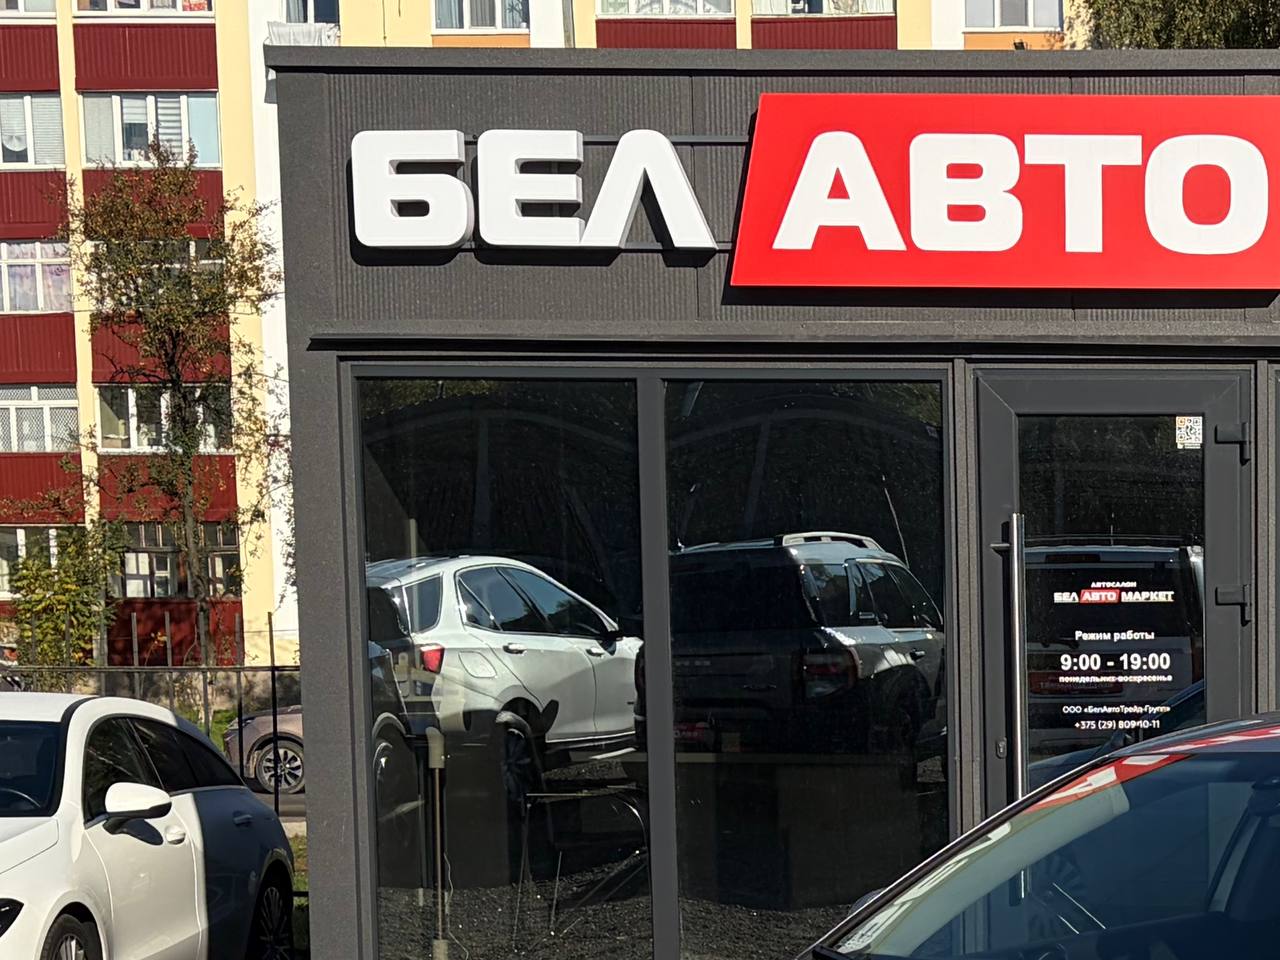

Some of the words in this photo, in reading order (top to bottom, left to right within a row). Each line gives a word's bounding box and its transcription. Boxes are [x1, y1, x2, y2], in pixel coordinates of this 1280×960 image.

[351, 129, 717, 250] БЕЛ
[772, 131, 1269, 254] АВТО
[1053, 592, 1079, 603] БЕЛ
[1082, 591, 1117, 601] АВТО
[1121, 591, 1174, 602] МАРКЕТ
[1075, 630, 1111, 641] Режим
[1113, 630, 1155, 642] работы
[1060, 653, 1101, 671] 9:00
[1119, 653, 1171, 670] 19:00
[1062, 705, 1082, 714] ООО
[1074, 720, 1096, 729] +375
[1098, 720, 1116, 730] (29)
